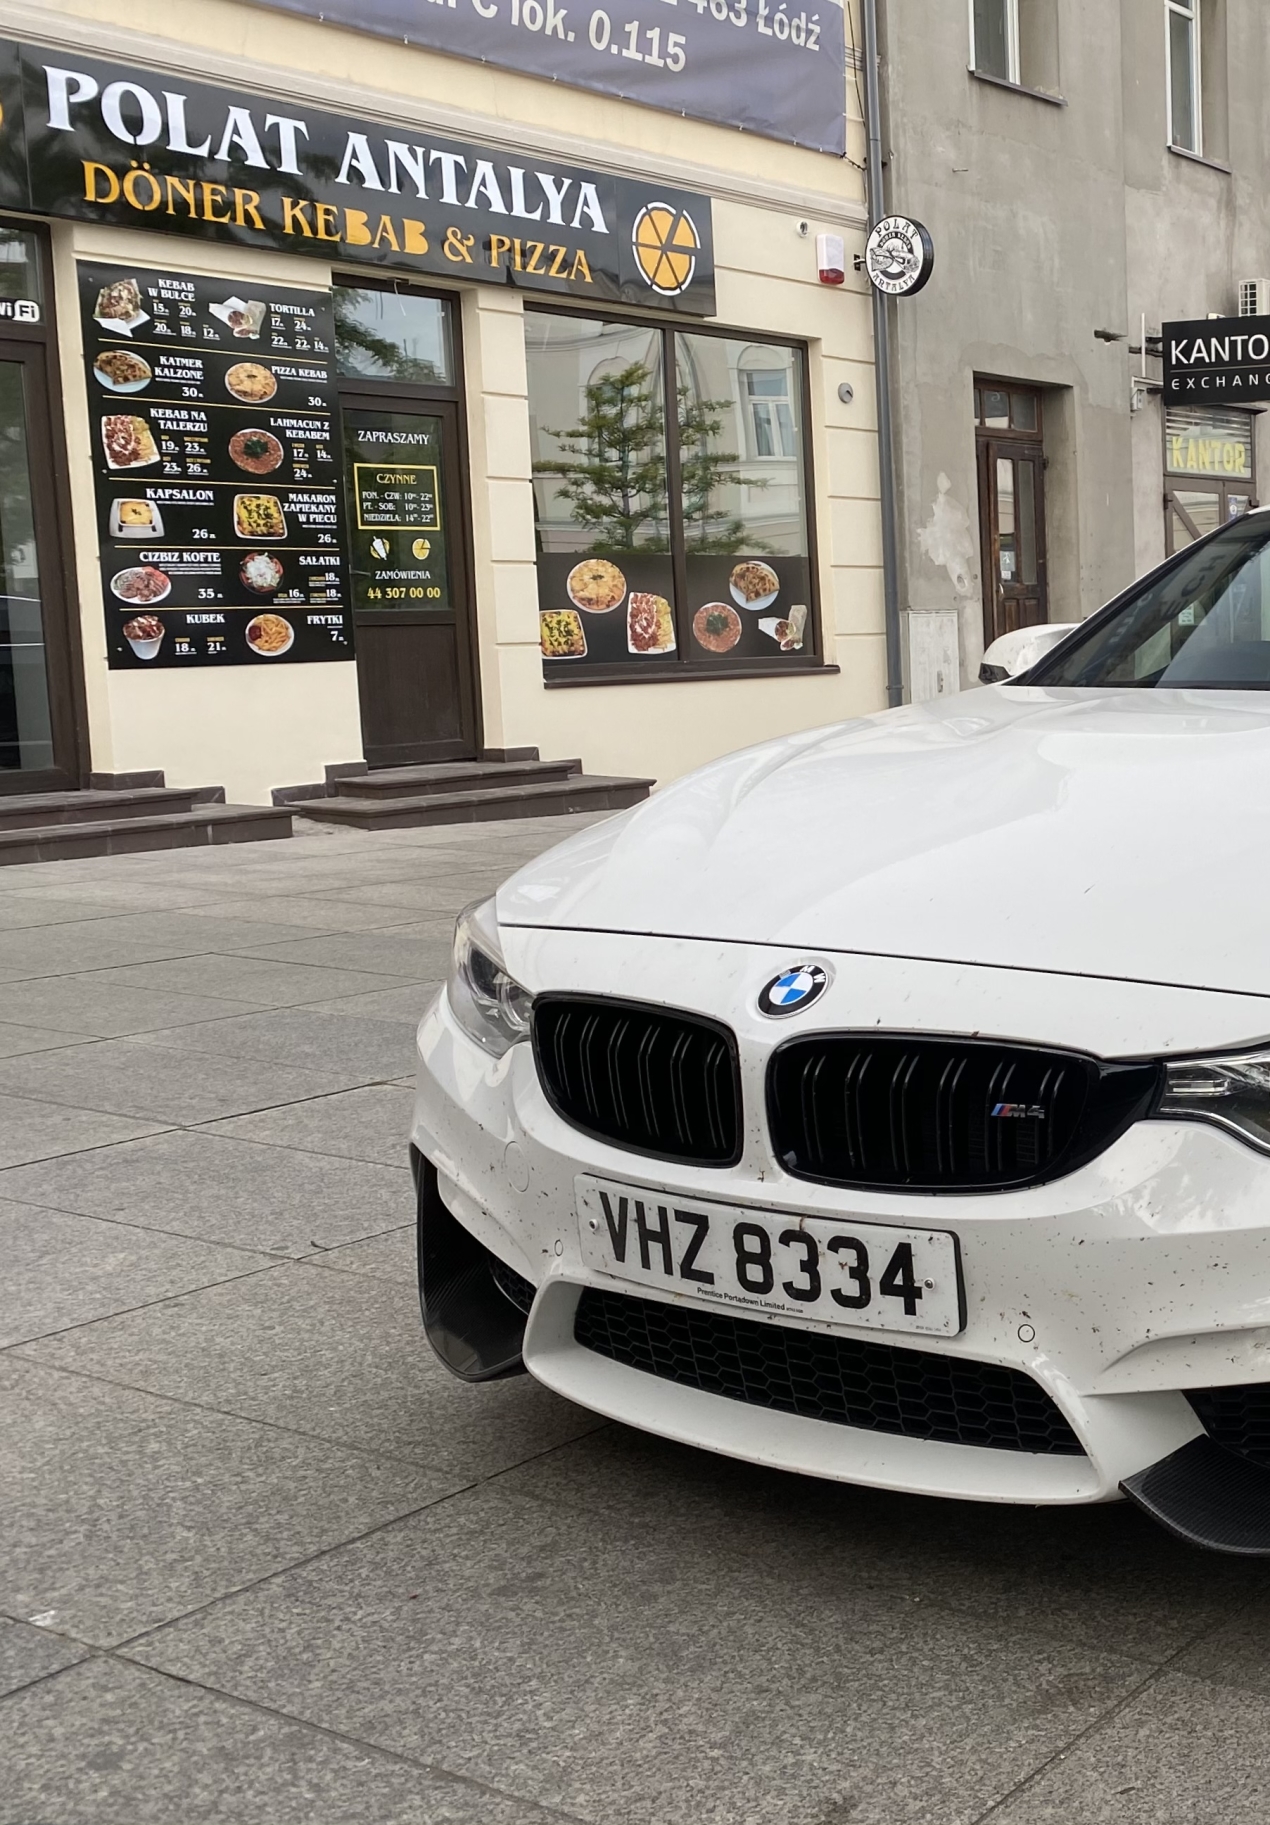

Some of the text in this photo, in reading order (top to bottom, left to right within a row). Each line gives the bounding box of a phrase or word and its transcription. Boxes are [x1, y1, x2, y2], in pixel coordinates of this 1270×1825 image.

[756, 0, 820, 51] Łódź
[511, 0, 686, 72] lok. 0.115
[42, 65, 610, 234] POLAT ANTALYA
[81, 160, 594, 283] DÖNER KEBAB & PIZZA
[875, 218, 919, 240] POLAT
[158, 279, 195, 291] KEBAB
[147, 287, 158, 297] W
[269, 303, 315, 317] TORTILLA
[159, 356, 203, 368] KATMER
[154, 367, 204, 379] KALZONE
[271, 365, 297, 376] PIZZA
[298, 369, 328, 379] KEBAB
[150, 408, 207, 421] KEBAB NA
[158, 420, 208, 432] TALERZU
[270, 417, 330, 430] LAHMACUN Z
[286, 429, 330, 440] KEBABEM
[358, 430, 430, 445] ZAPRASZAMY
[1172, 436, 1246, 474] KANTOR
[376, 473, 417, 485] CZYNNE
[146, 488, 214, 500] KAPSALON
[288, 493, 336, 503] MAKARON
[283, 503, 336, 513] ZAPIEKANY
[298, 513, 337, 523] W PIECU
[139, 552, 180, 562] CIZBIZ
[299, 556, 340, 566] SAŁATKI
[375, 569, 431, 580] ZAMÓWIENIA
[367, 587, 441, 599] 44 307 00 00
[186, 613, 225, 624] KUBEK
[307, 615, 343, 625] FRYTKI
[599, 1191, 923, 1316] VHZ 8334
[697, 1287, 723, 1299] Prentice
[760, 1299, 785, 1310] Limited
